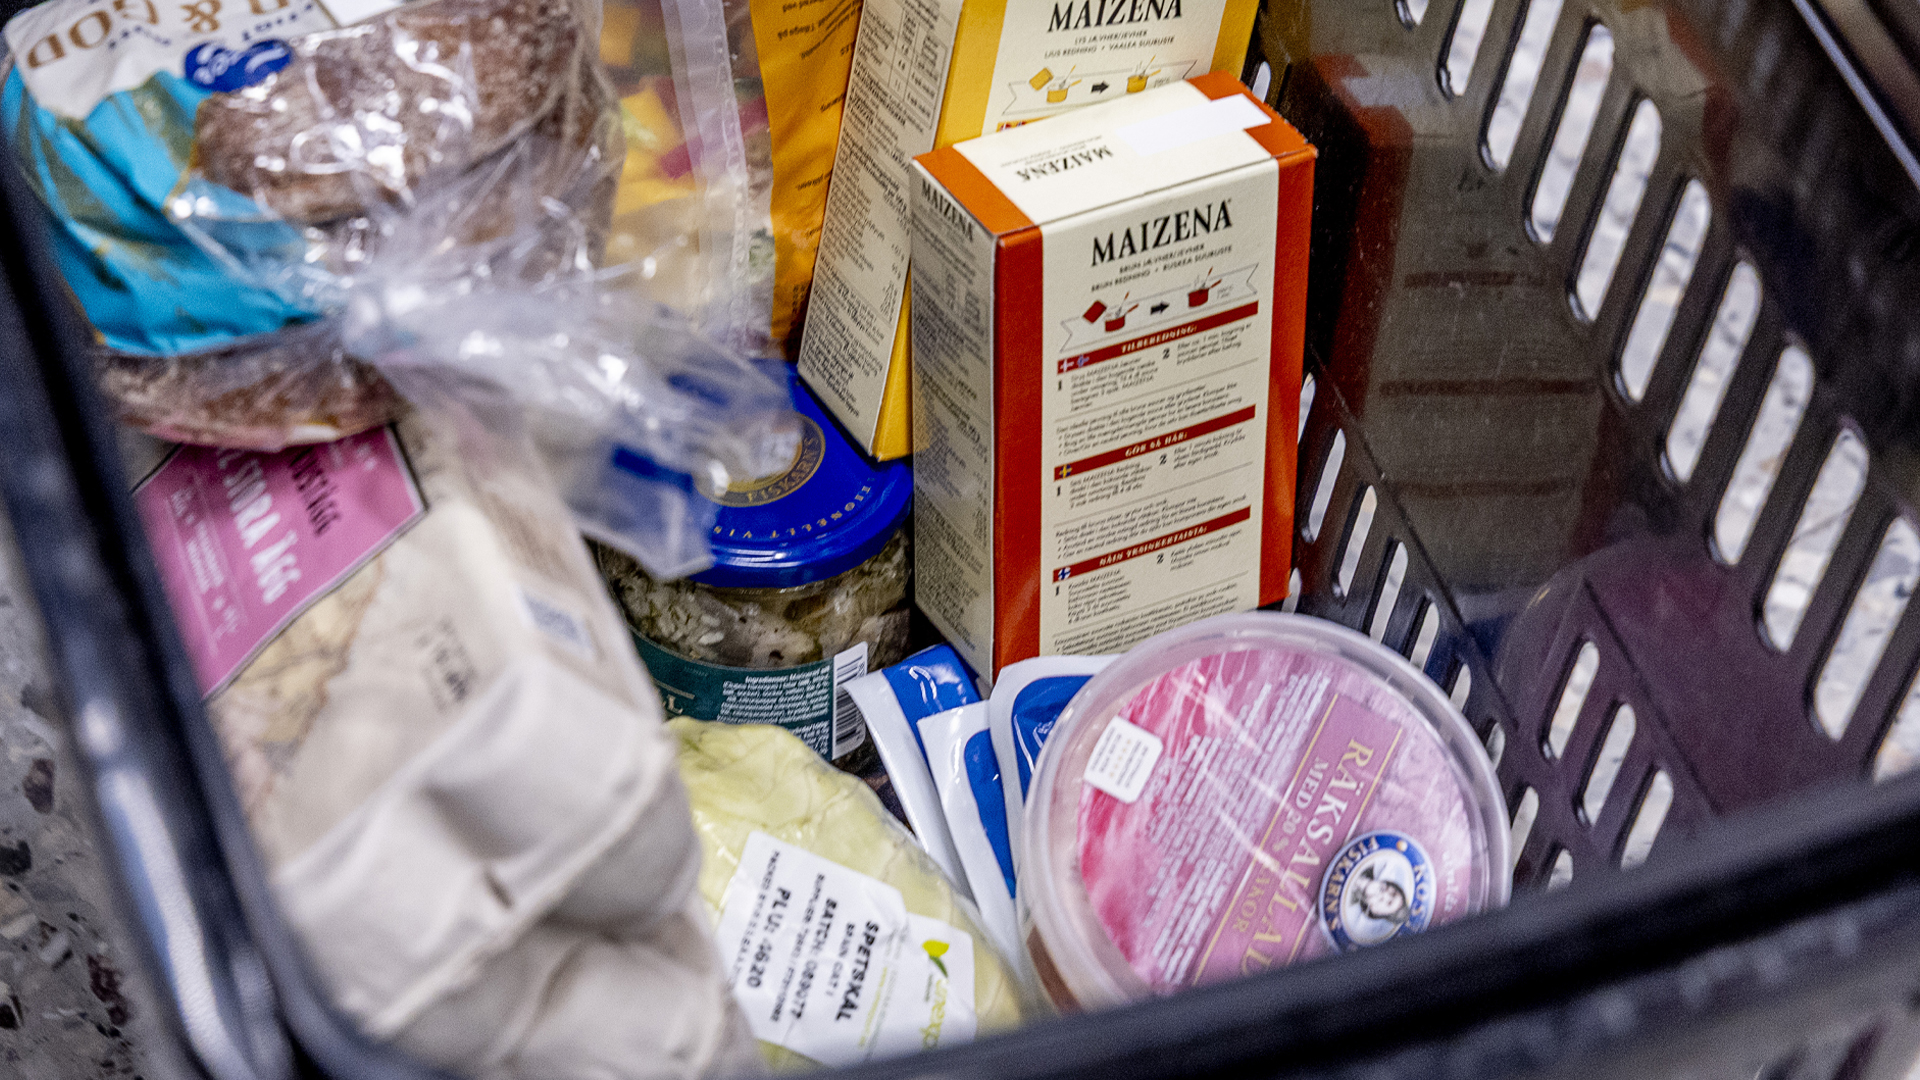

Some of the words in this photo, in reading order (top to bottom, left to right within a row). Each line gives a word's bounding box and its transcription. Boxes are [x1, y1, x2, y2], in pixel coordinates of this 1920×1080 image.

[1048, 0, 1182, 32] MAIZENA
[1016, 145, 1114, 183] MAIZENA
[921, 177, 975, 243] MAIZENA
[1091, 198, 1233, 267] MAIZENA
[222, 461, 280, 550] STORA
[1293, 757, 1331, 809] MED
[765, 888, 791, 934] PLU:
[811, 898, 838, 954] BATCH:
[747, 939, 773, 988] 4620
[834, 921, 880, 1021] SPETSKÅL
